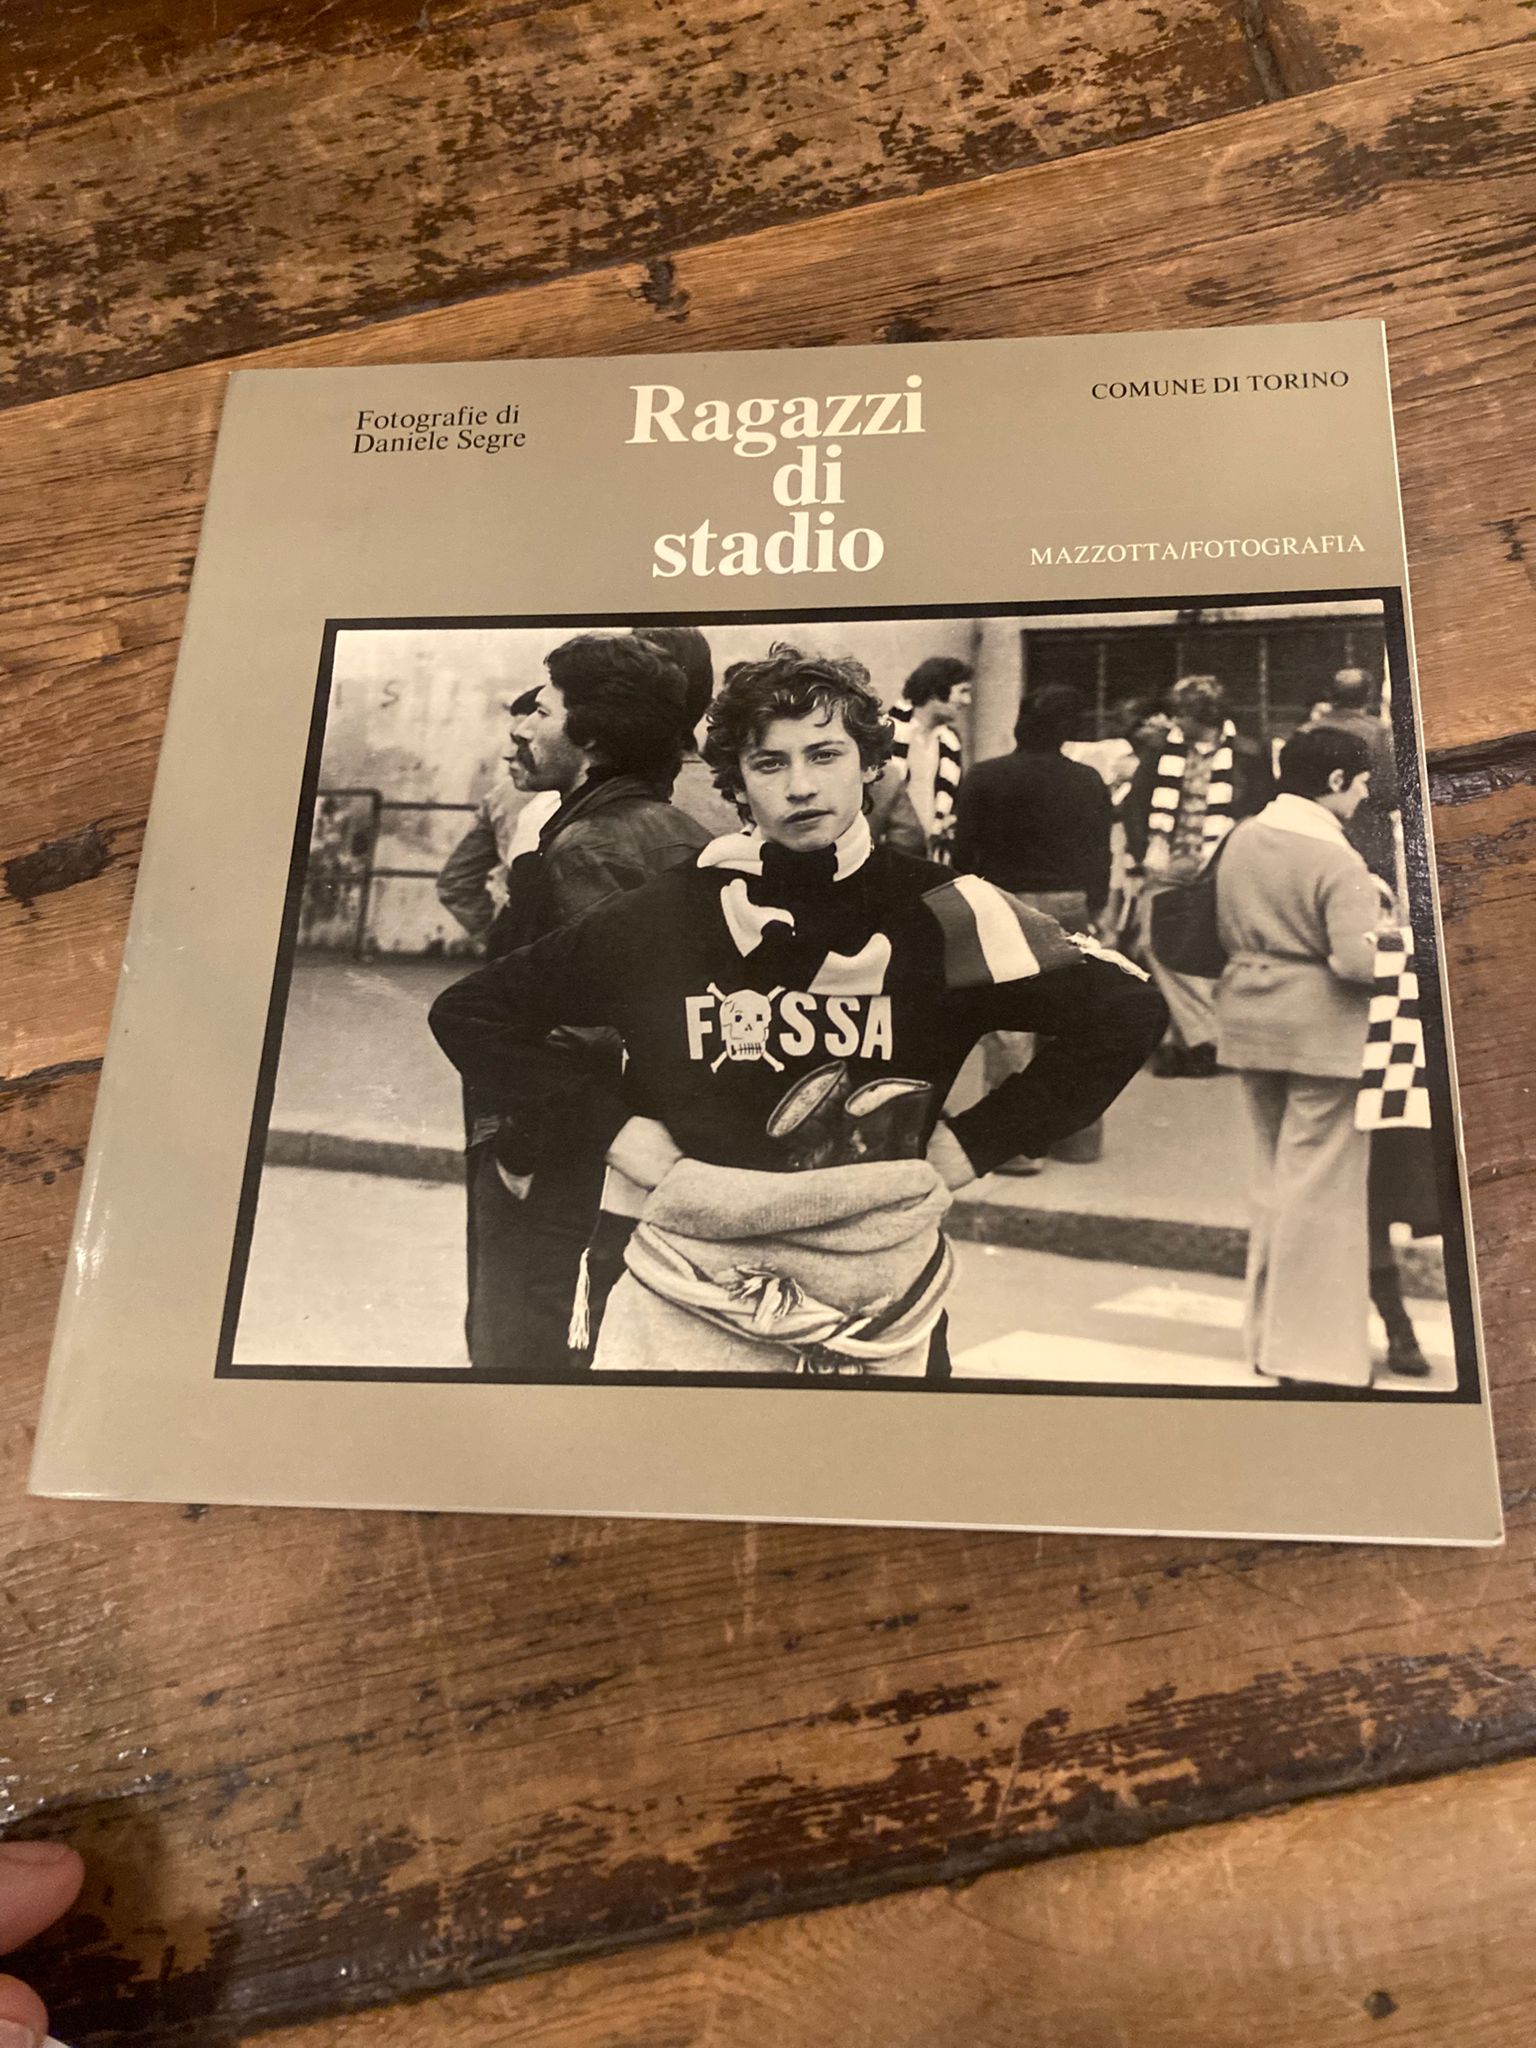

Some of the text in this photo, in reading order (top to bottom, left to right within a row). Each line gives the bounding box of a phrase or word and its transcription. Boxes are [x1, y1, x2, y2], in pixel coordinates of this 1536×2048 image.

[1092, 369, 1349, 400] COMUNE DI TORINO
[356, 404, 520, 433] Fotografie di
[625, 375, 926, 458] Ragazzi
[353, 429, 526, 455] Daniele Segre
[773, 445, 845, 507] di
[652, 511, 885, 578] stadio
[1030, 534, 1365, 566] MAZZOTTA/FOTOGRAFIA
